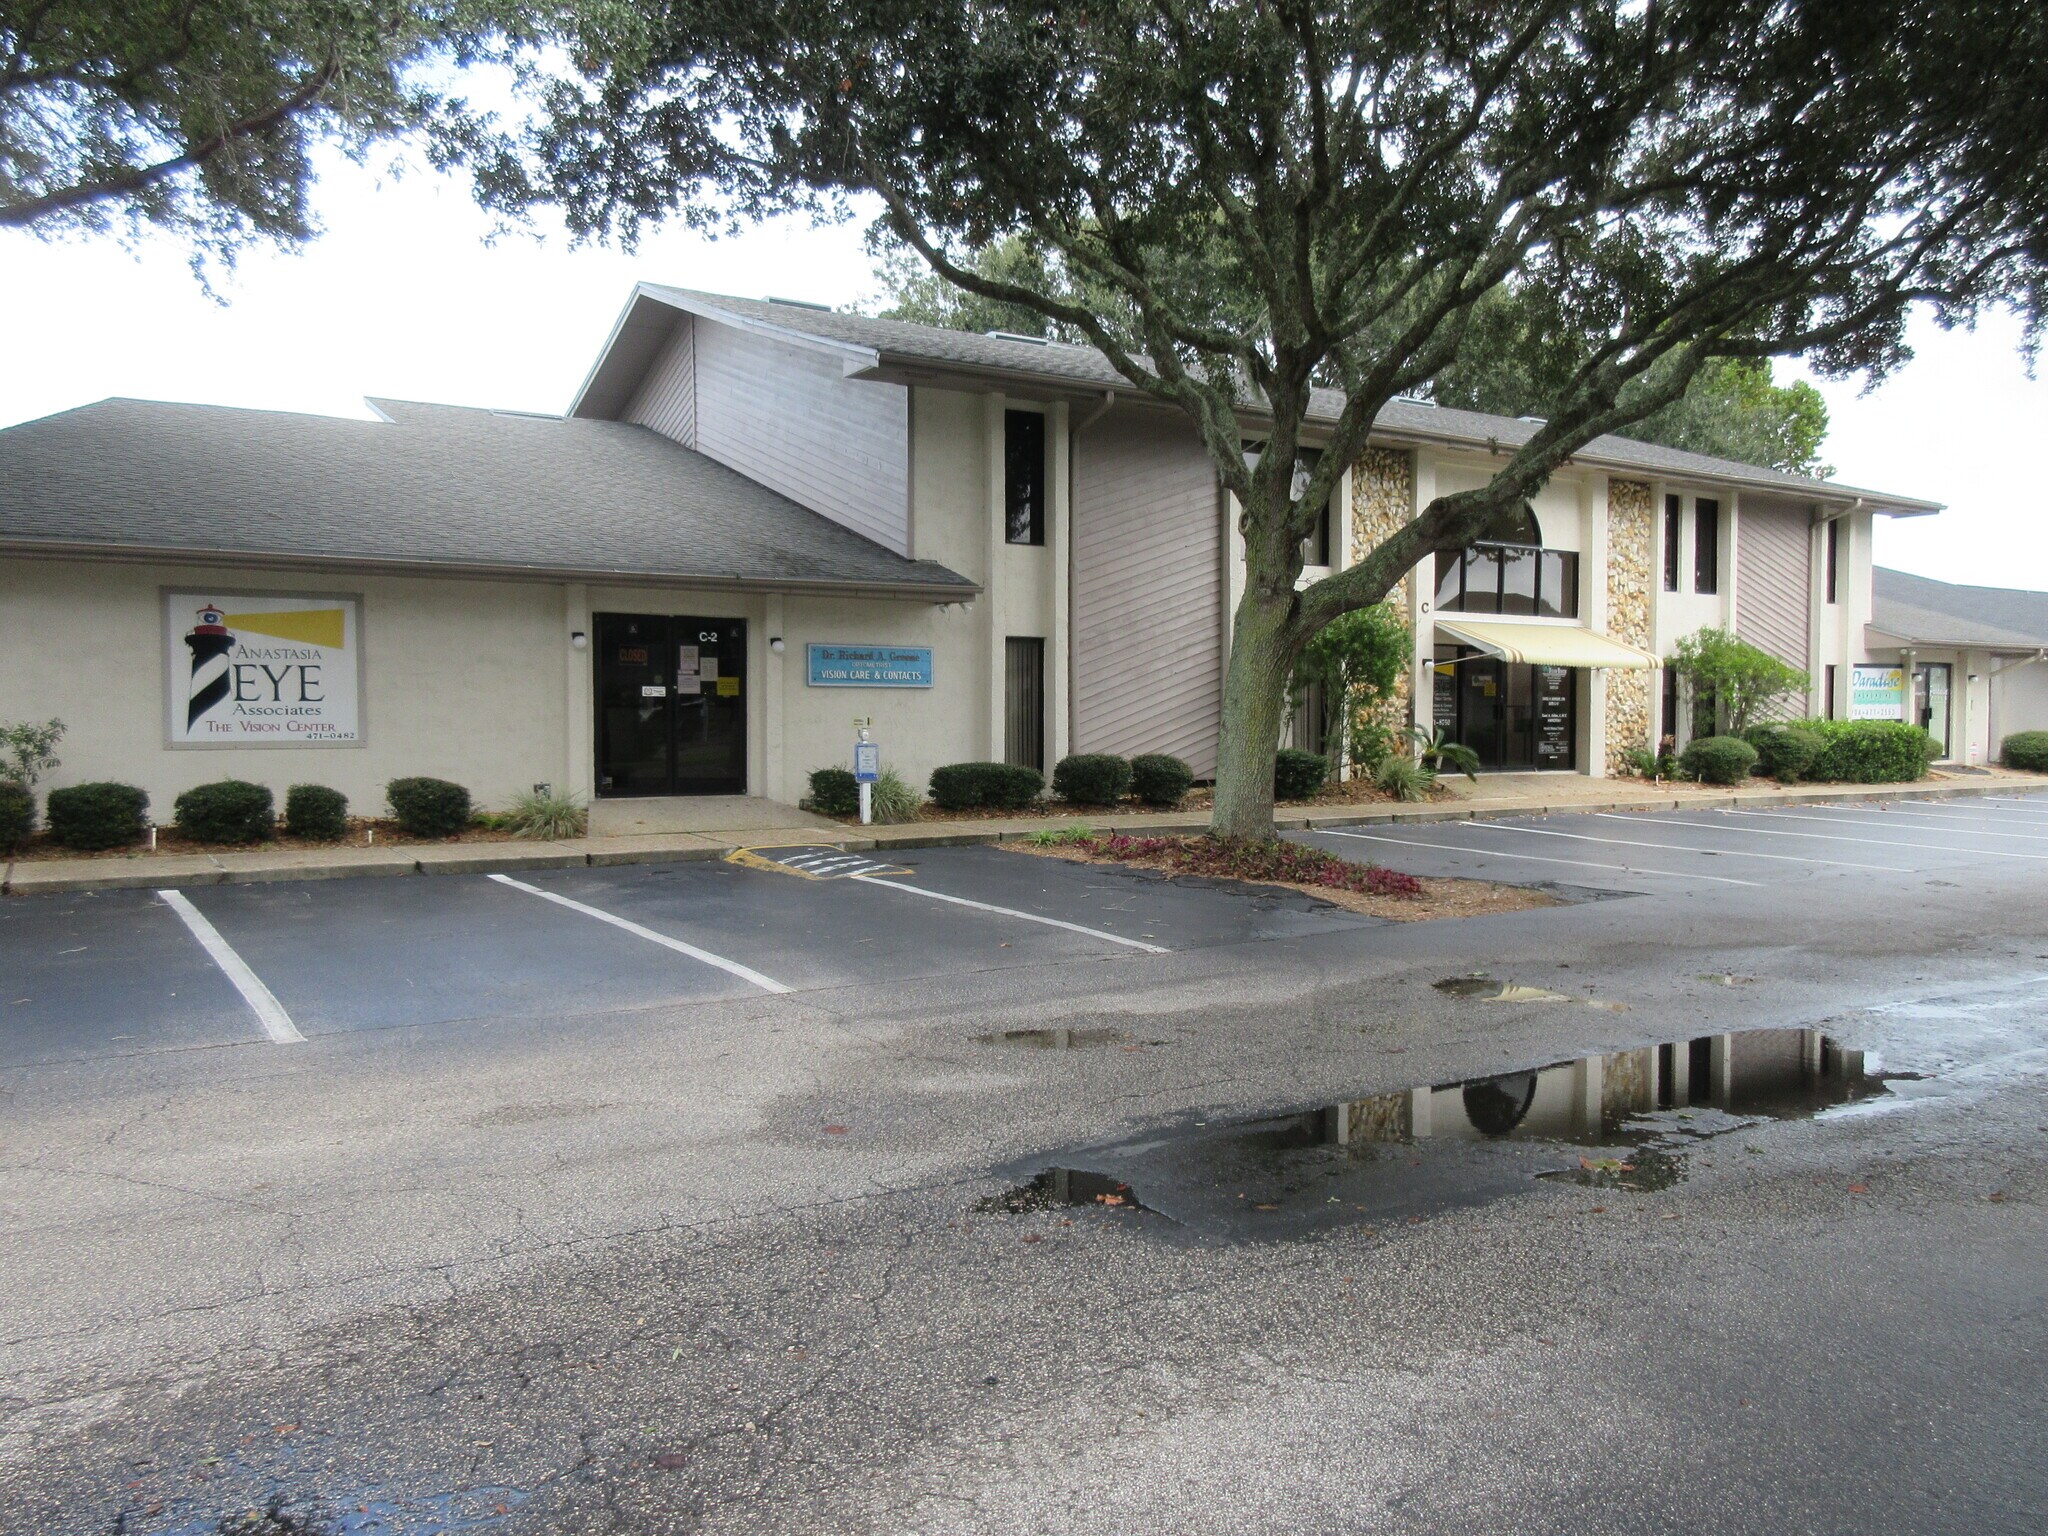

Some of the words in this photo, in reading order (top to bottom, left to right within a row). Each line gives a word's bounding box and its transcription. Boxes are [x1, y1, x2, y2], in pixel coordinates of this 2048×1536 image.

[1421, 602, 1430, 613] C
[699, 632, 718, 642] C-2
[236, 645, 322, 660] ANASTASIA
[821, 670, 847, 679] VISION
[850, 670, 870, 679] CARE
[874, 671, 880, 679] &
[883, 671, 922, 680] CONTACTS
[232, 664, 326, 702] EYE
[232, 703, 322, 716] Associates
[206, 720, 233, 732] THE
[240, 720, 280, 732] VISION
[286, 720, 336, 732] CENTER
[306, 732, 355, 740] 471-0482
